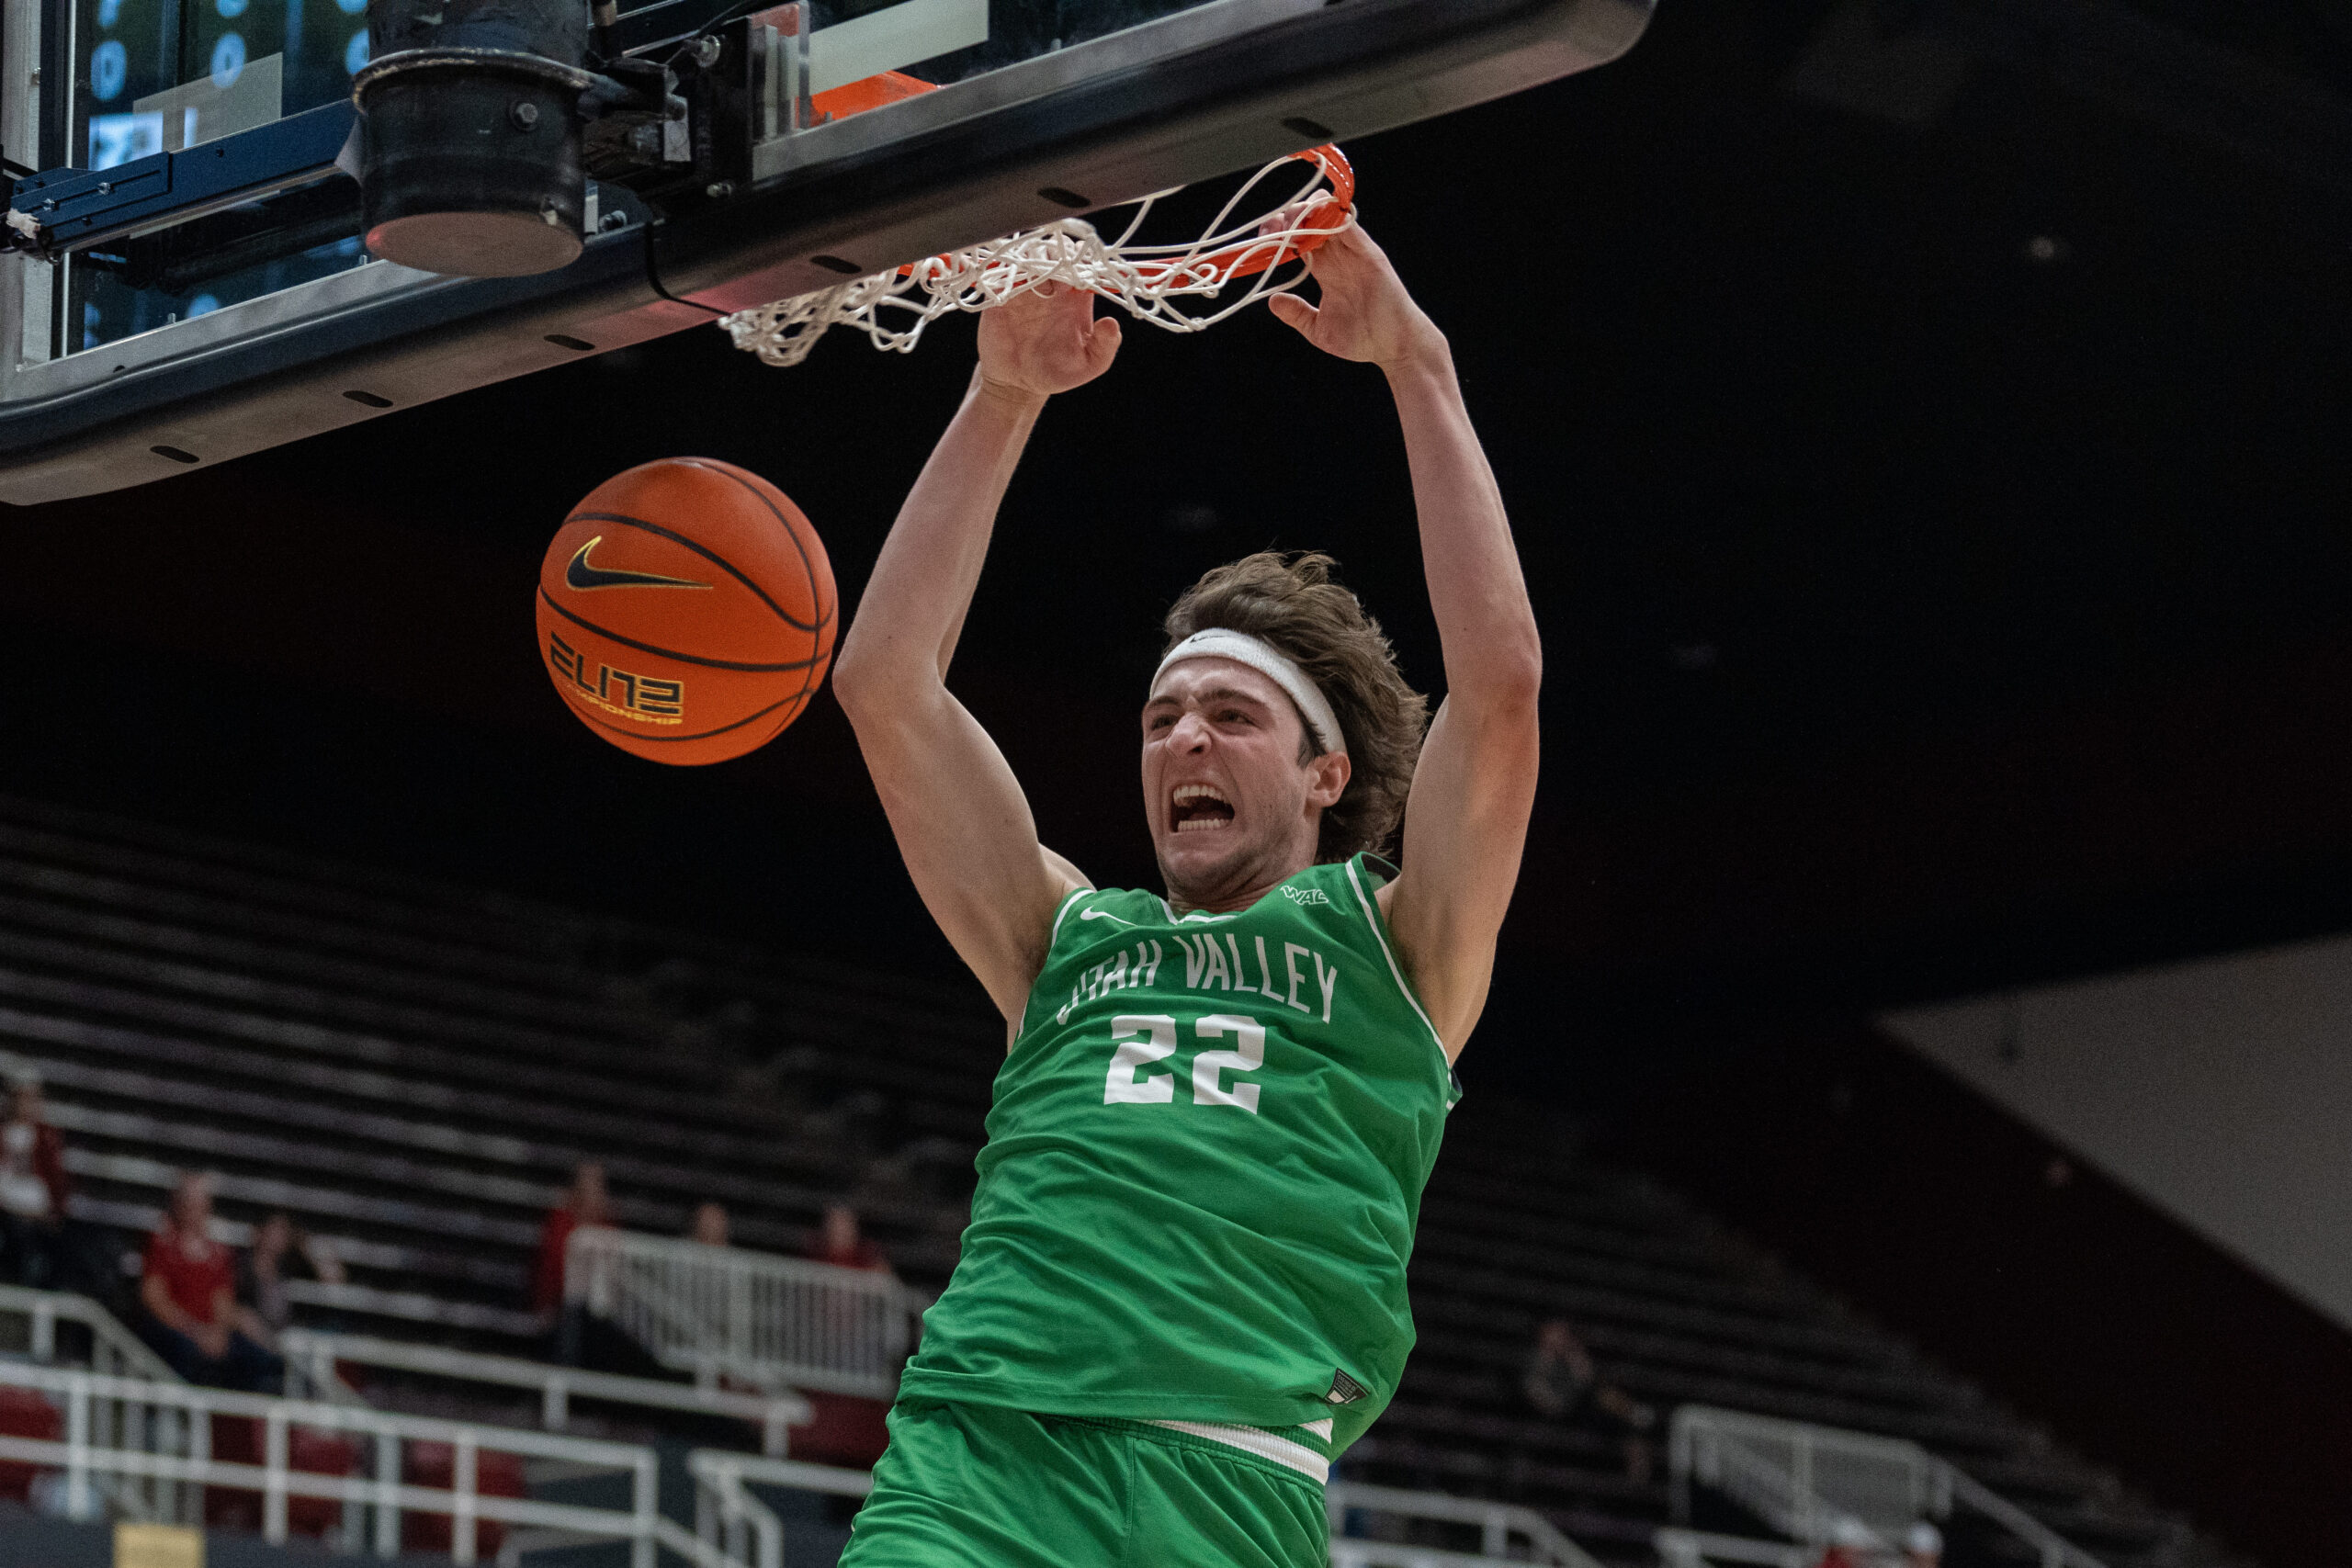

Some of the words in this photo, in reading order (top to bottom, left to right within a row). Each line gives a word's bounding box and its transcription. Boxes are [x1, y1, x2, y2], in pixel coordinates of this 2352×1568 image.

[550, 630, 684, 716] ELITE
[1280, 885, 1329, 906] WAC
[1171, 932, 1339, 1025] VALLEY
[1103, 1013, 1266, 1116] 22
